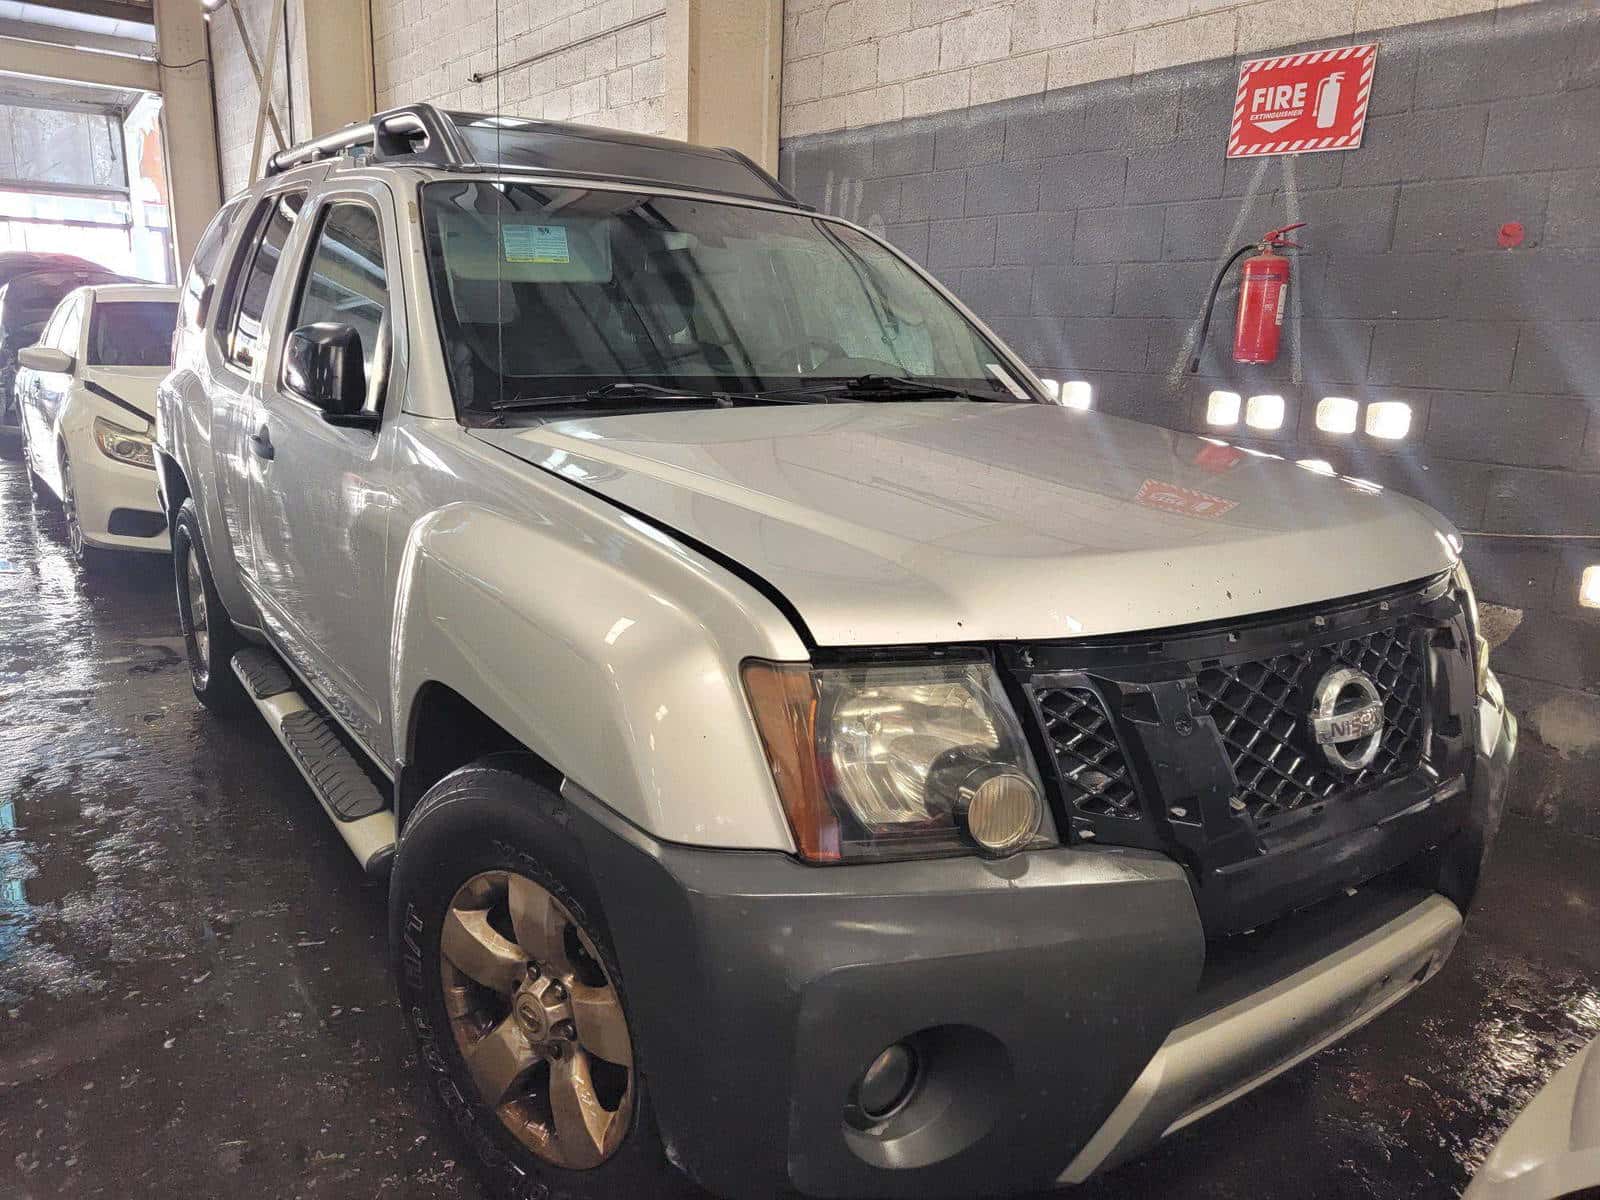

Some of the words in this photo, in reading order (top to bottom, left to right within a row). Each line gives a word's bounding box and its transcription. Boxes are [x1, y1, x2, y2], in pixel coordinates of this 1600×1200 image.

[1251, 82, 1308, 112] FIRE
[1250, 109, 1304, 120] EXTINGUISHER
[1330, 708, 1377, 738] NISS
